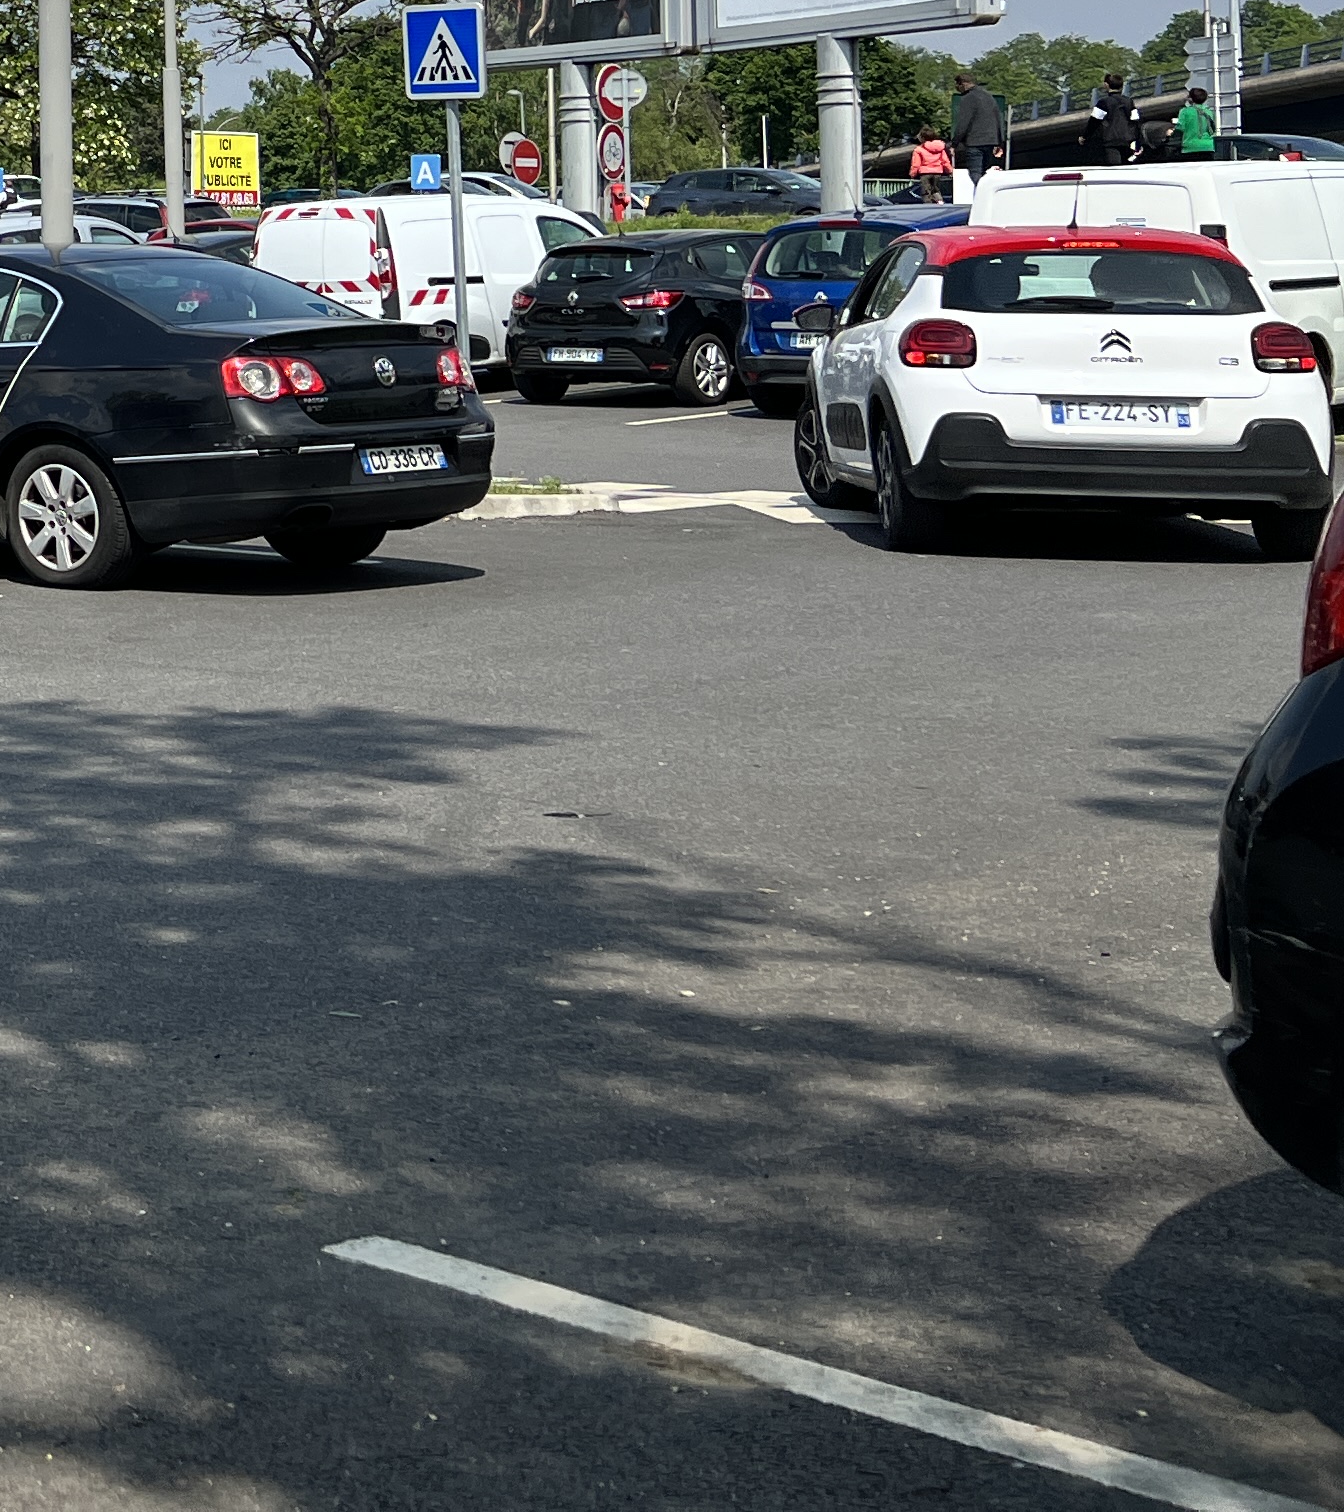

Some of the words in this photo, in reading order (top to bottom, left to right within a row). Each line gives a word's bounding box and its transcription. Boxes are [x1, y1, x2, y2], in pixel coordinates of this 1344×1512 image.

[219, 139, 232, 150] ICI
[209, 156, 242, 169] VOTRE
[202, 172, 252, 186] UBLICITÉ
[416, 161, 435, 185] A
[1219, 357, 1240, 366] C3
[1065, 401, 1172, 423] FE-224-SY
[369, 447, 438, 470] CD-336-CR
